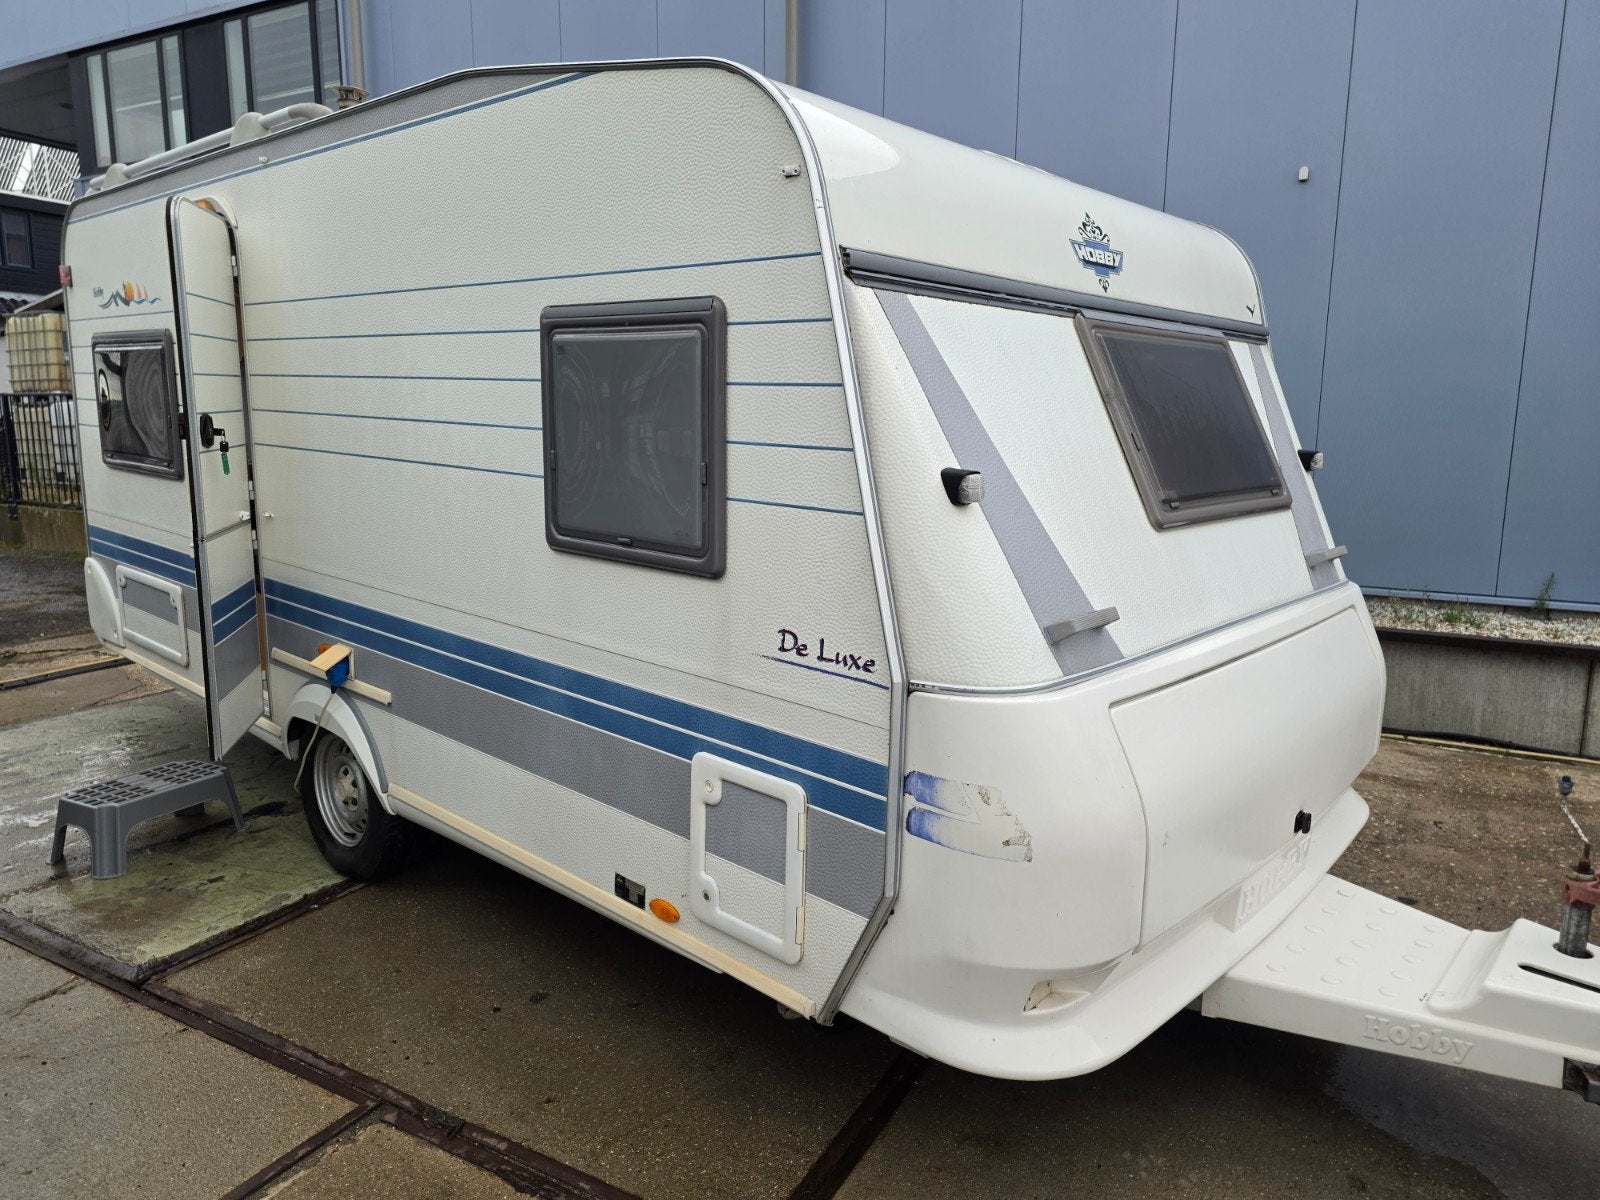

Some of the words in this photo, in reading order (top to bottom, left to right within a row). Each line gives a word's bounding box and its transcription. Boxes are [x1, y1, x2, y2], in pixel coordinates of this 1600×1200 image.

[1073, 243, 1121, 267] HOBBY
[778, 629, 809, 657] De
[817, 638, 876, 673] Luxe
[1362, 1015, 1474, 1065] Hobby
